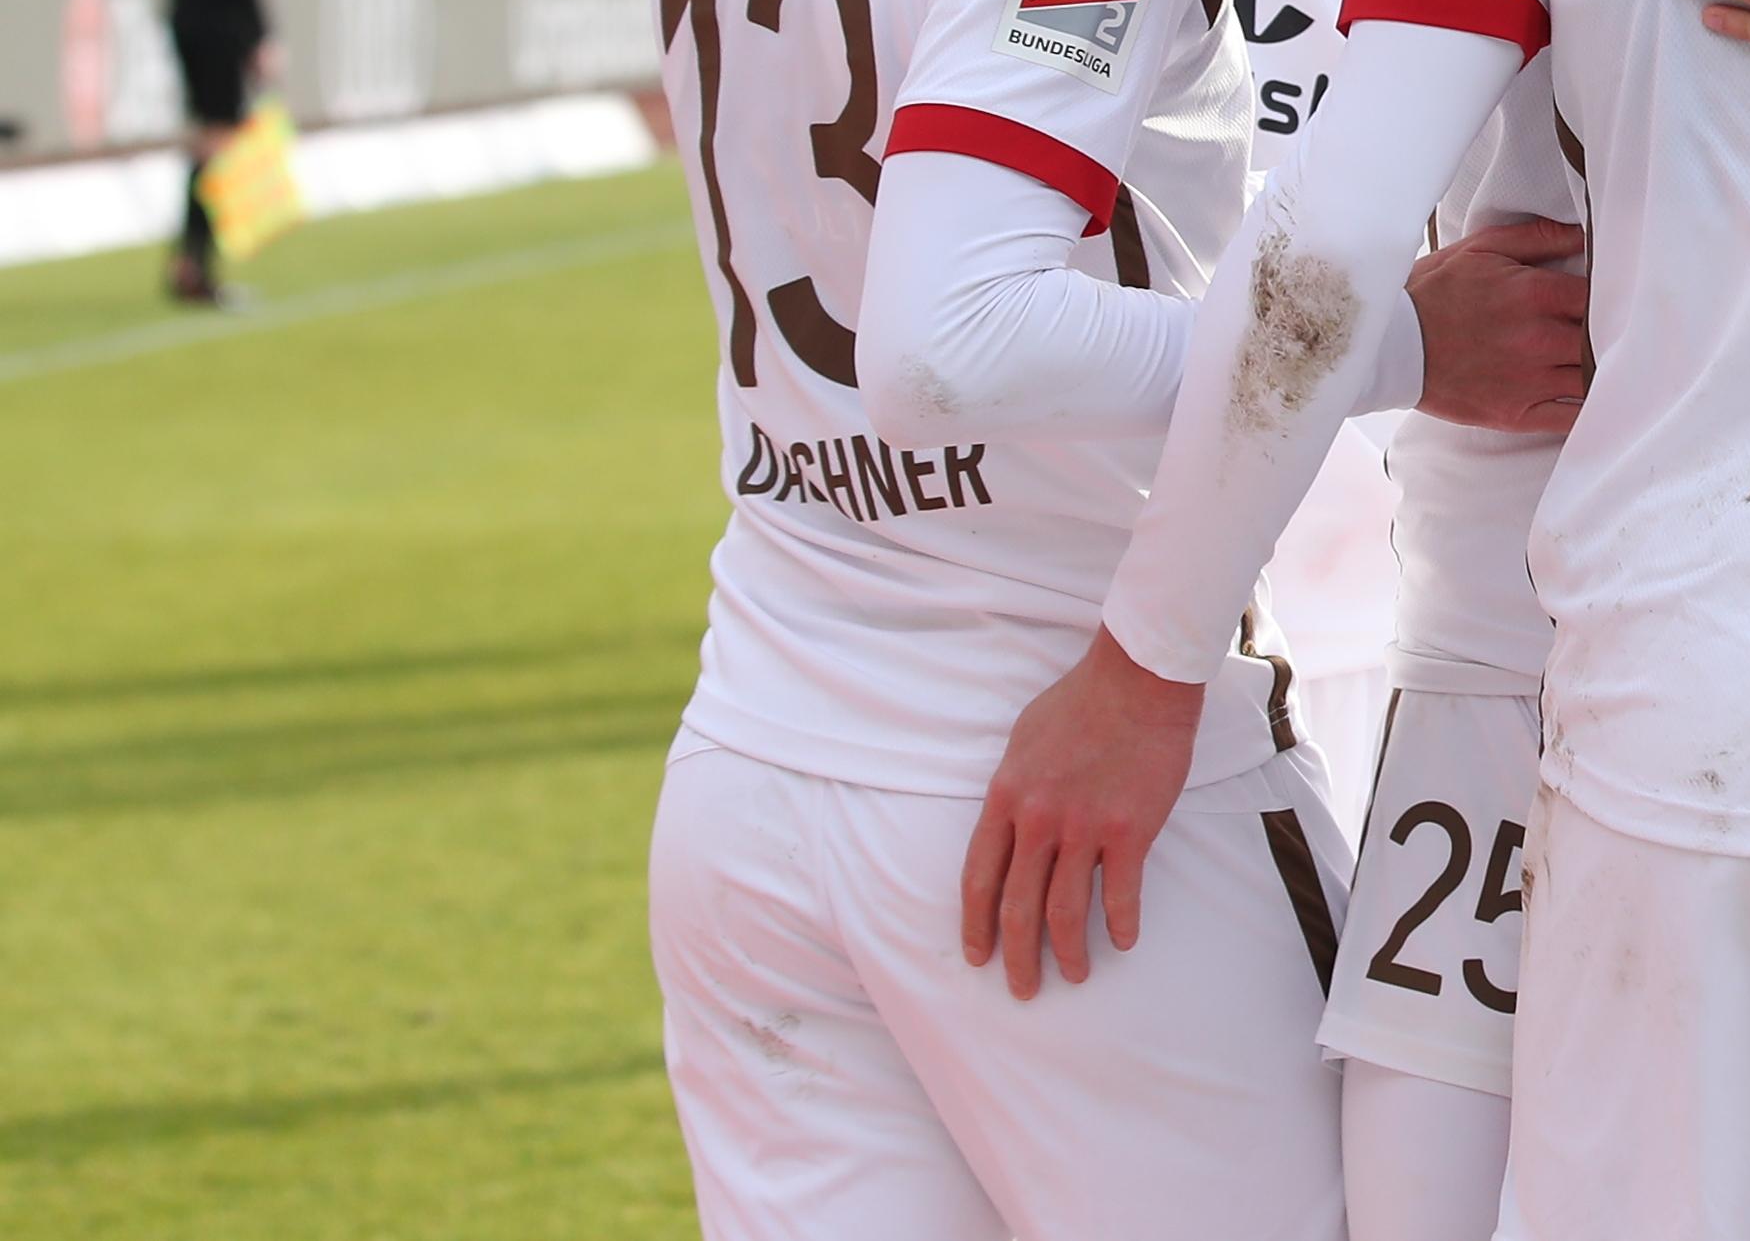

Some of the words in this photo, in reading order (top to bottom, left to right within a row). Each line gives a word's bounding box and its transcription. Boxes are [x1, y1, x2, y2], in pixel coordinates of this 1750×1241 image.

[1096, 3, 1126, 46] 2
[1008, 29, 1111, 78] BUNDESLIGA
[1366, 801, 1526, 1014] 25
